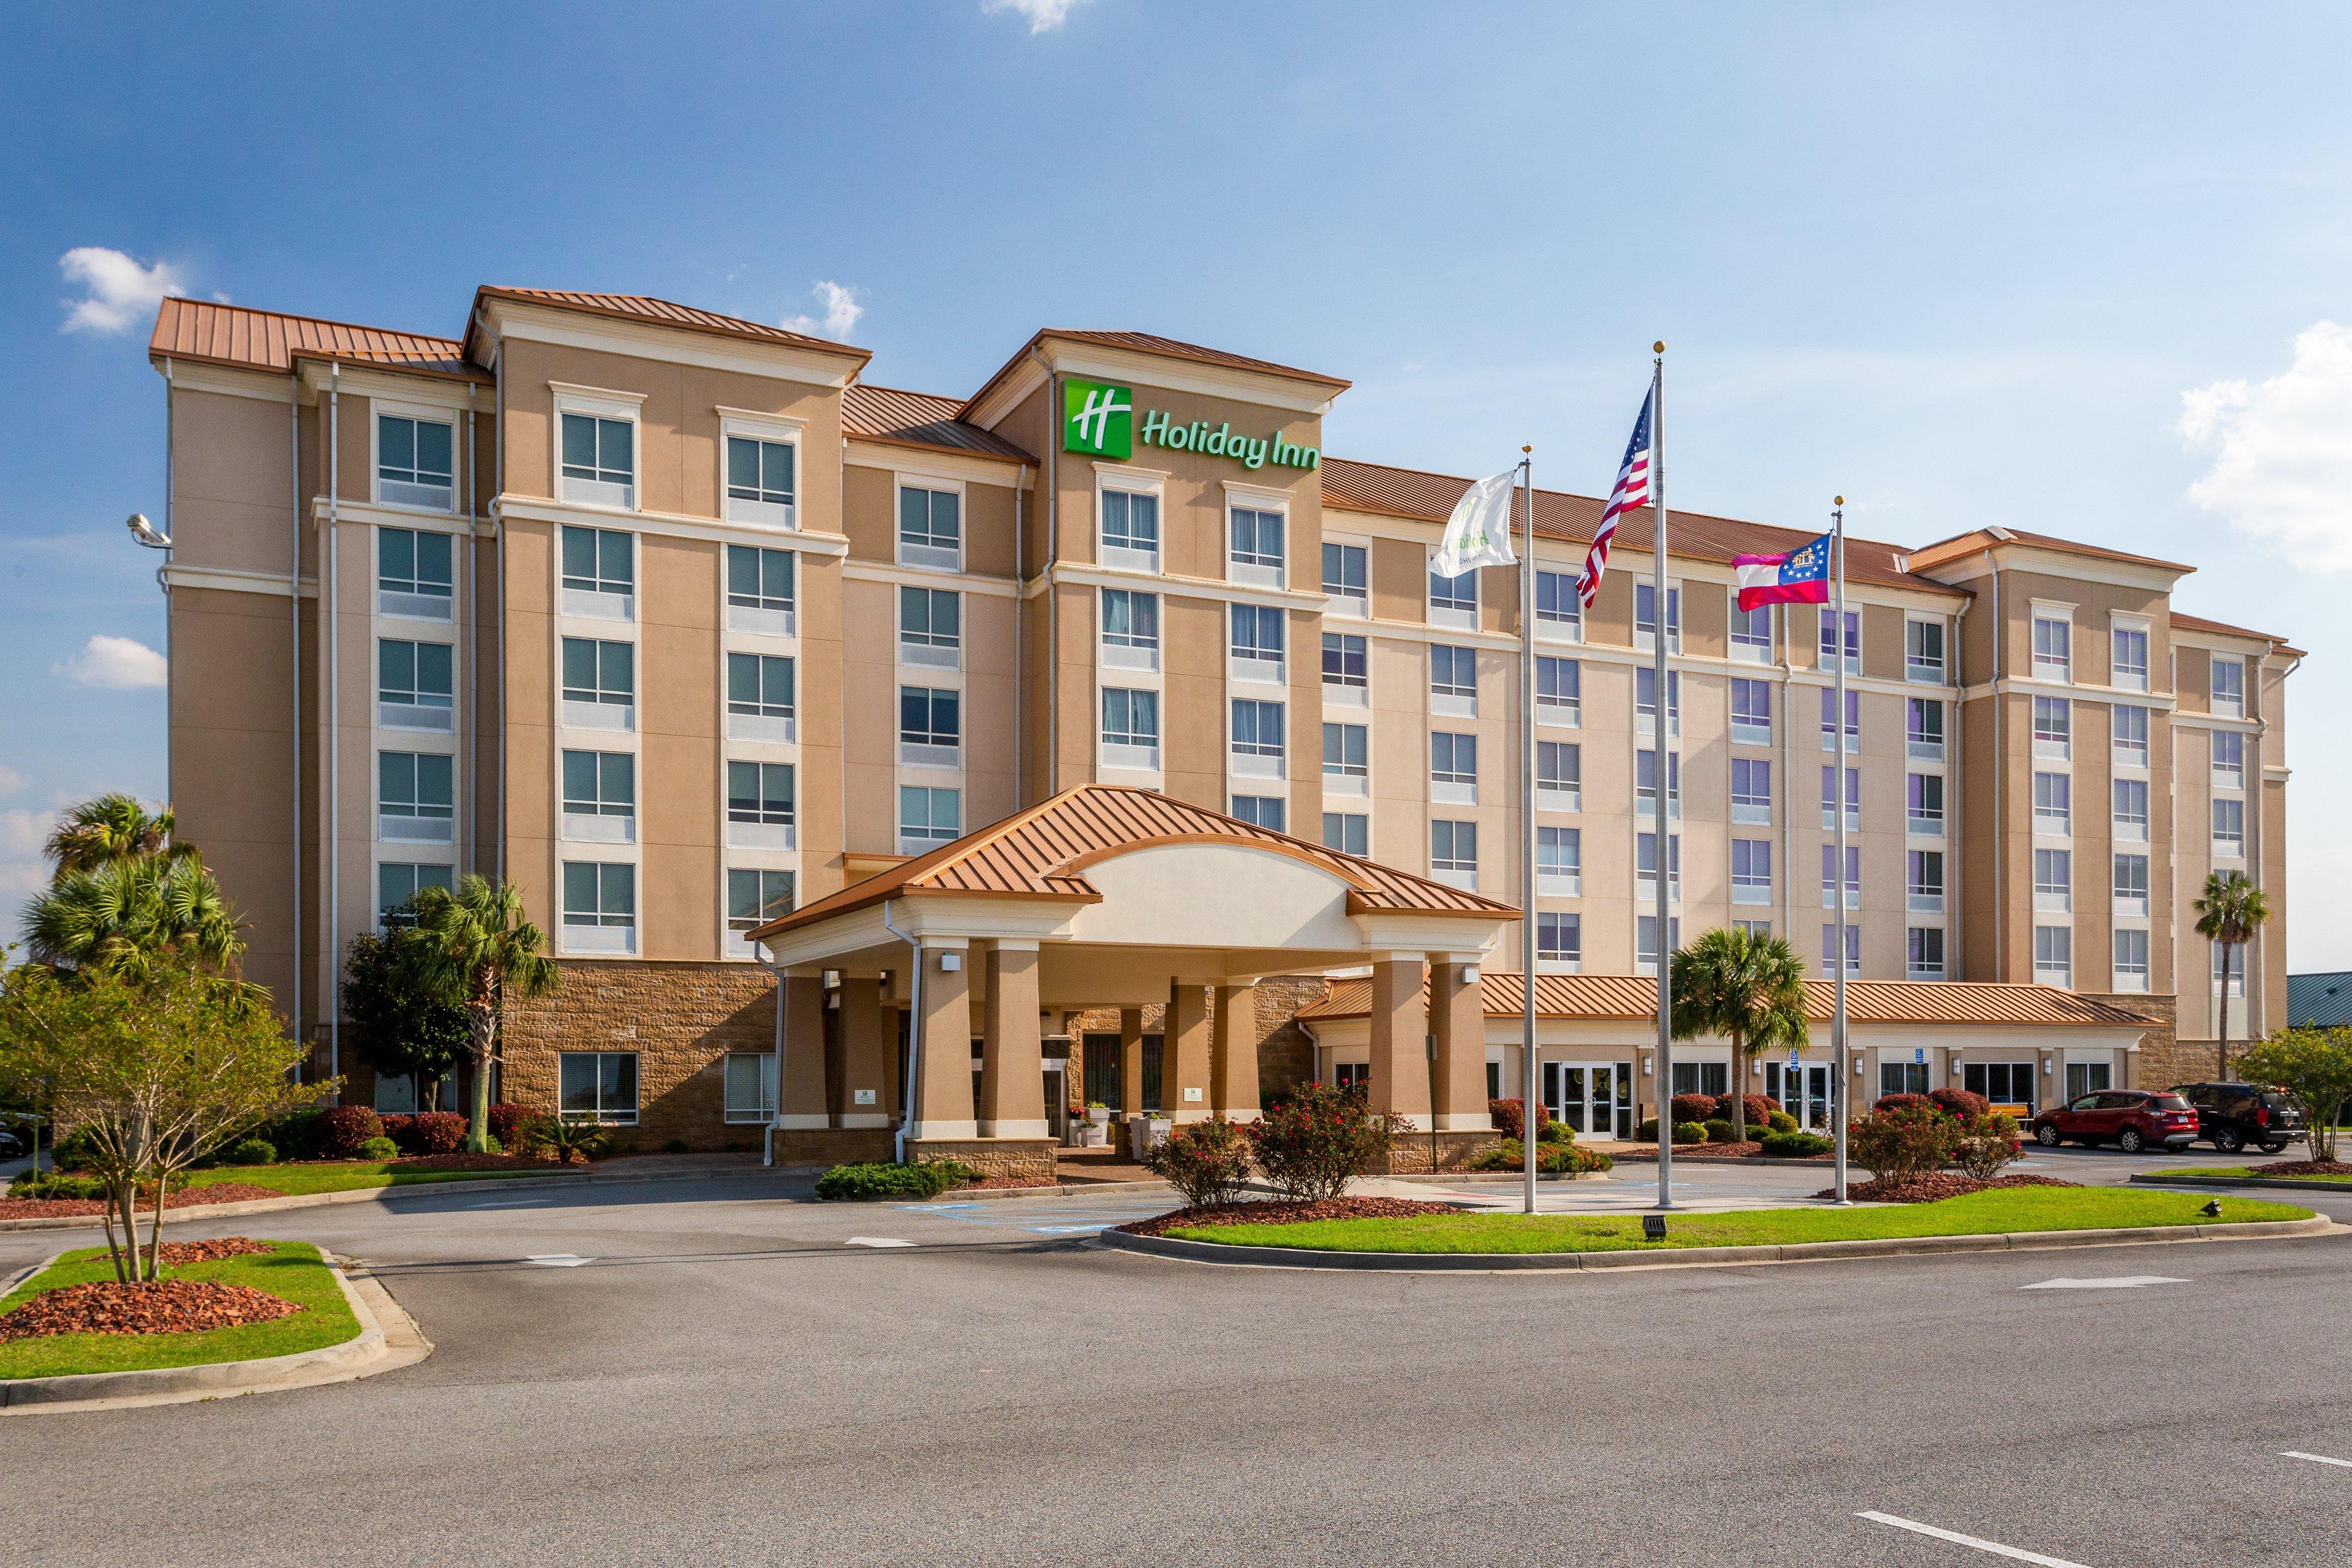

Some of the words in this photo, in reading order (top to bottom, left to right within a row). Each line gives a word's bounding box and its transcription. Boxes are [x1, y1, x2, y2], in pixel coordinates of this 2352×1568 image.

[1072, 388, 1131, 449] H
[1141, 409, 1268, 469] Holiday
[1272, 430, 1320, 470] Inn
